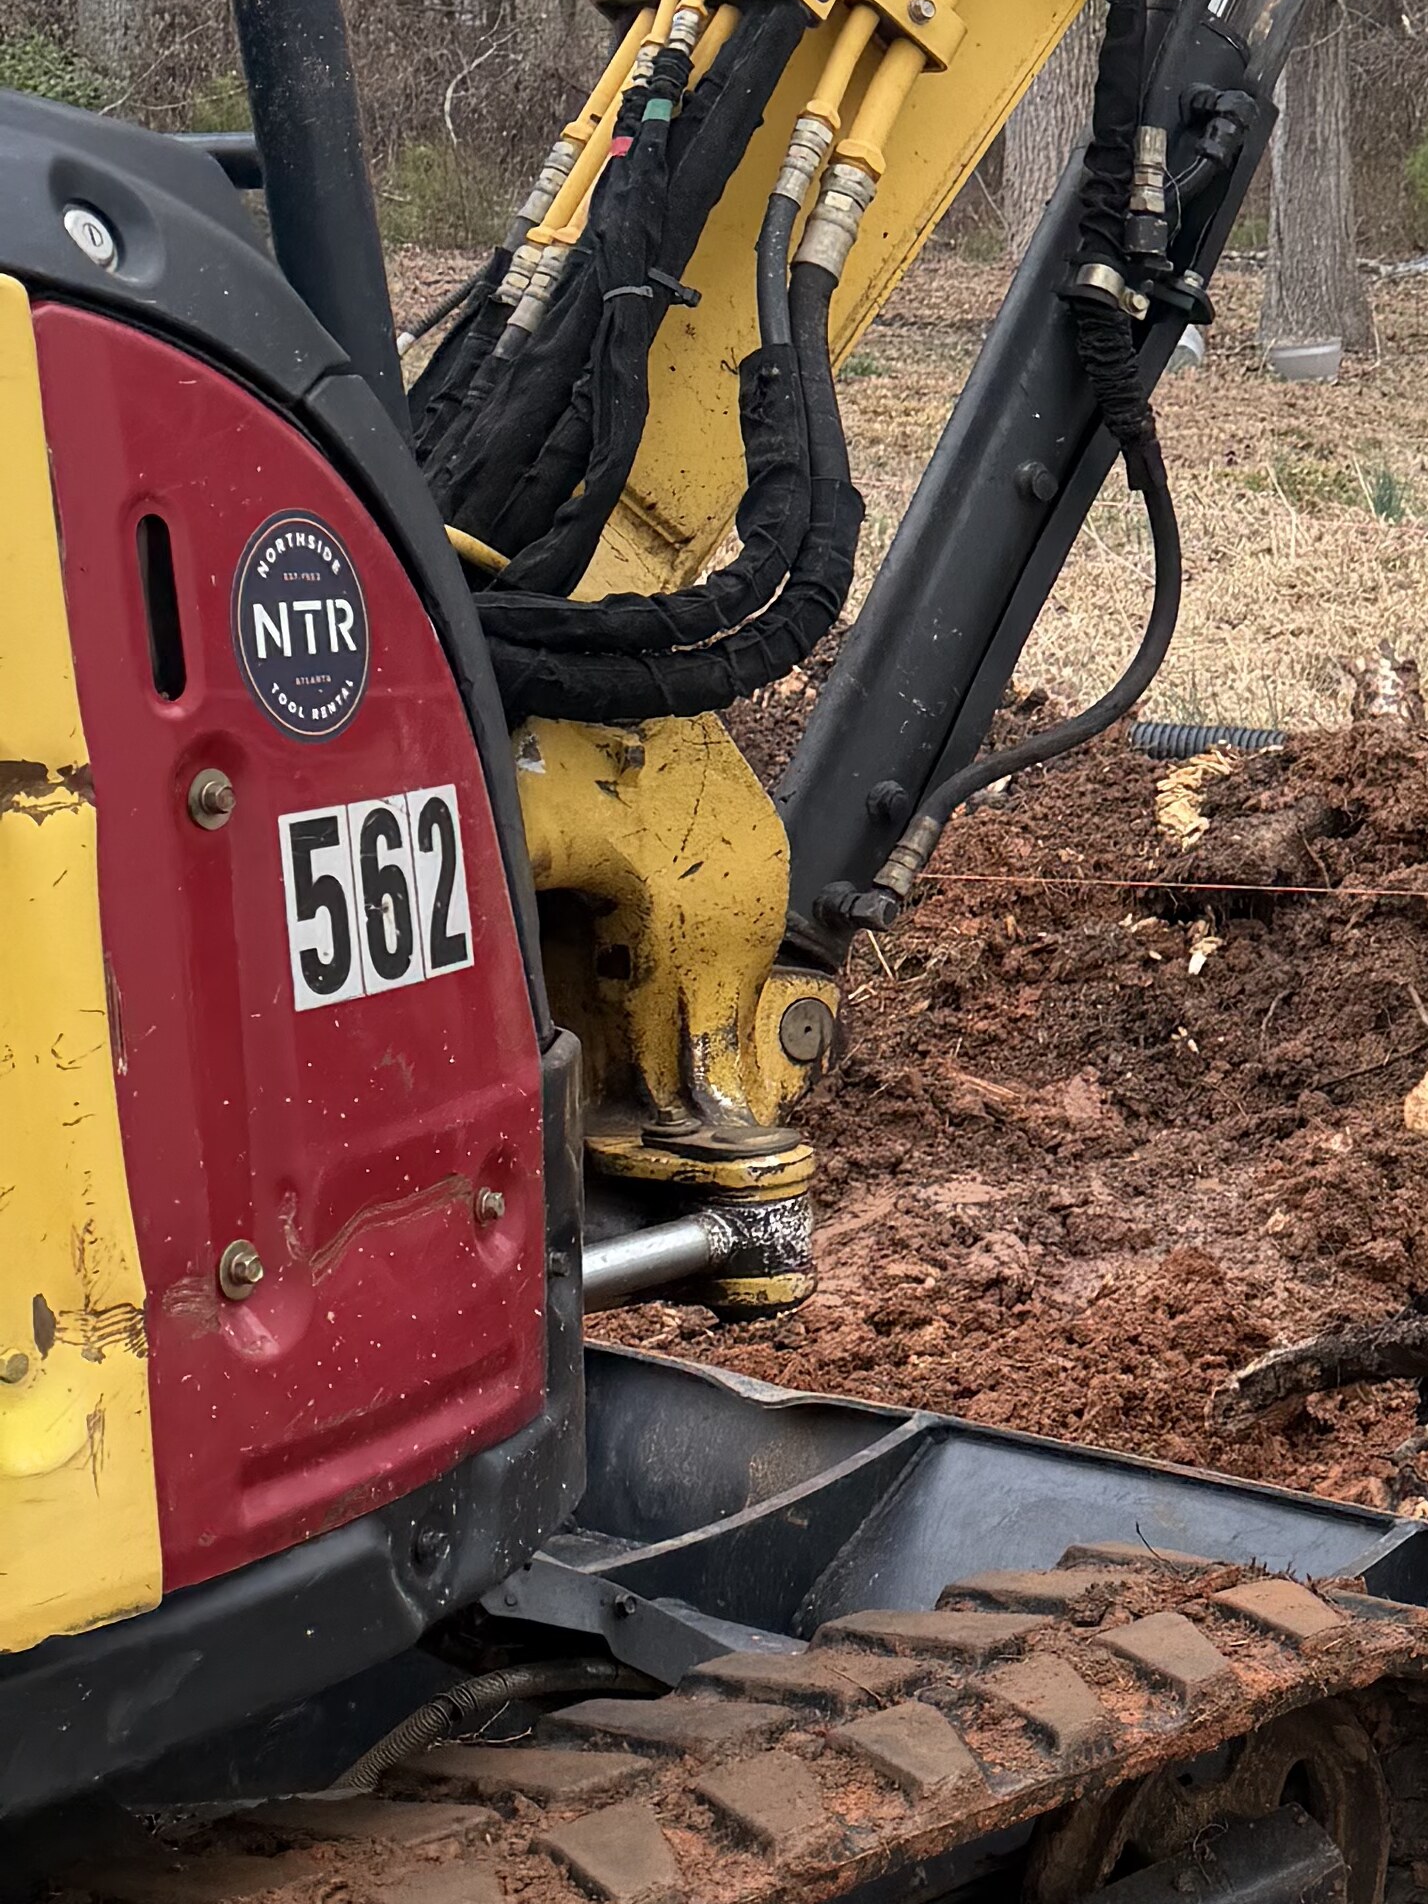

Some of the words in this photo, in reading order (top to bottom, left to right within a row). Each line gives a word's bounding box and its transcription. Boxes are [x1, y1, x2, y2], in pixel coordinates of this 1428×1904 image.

[257, 532, 340, 578] NORTHSIDE
[253, 598, 357, 659] NTR
[272, 682, 304, 718] TOOL
[312, 680, 354, 720] RENTAL
[289, 796, 468, 995] 562
